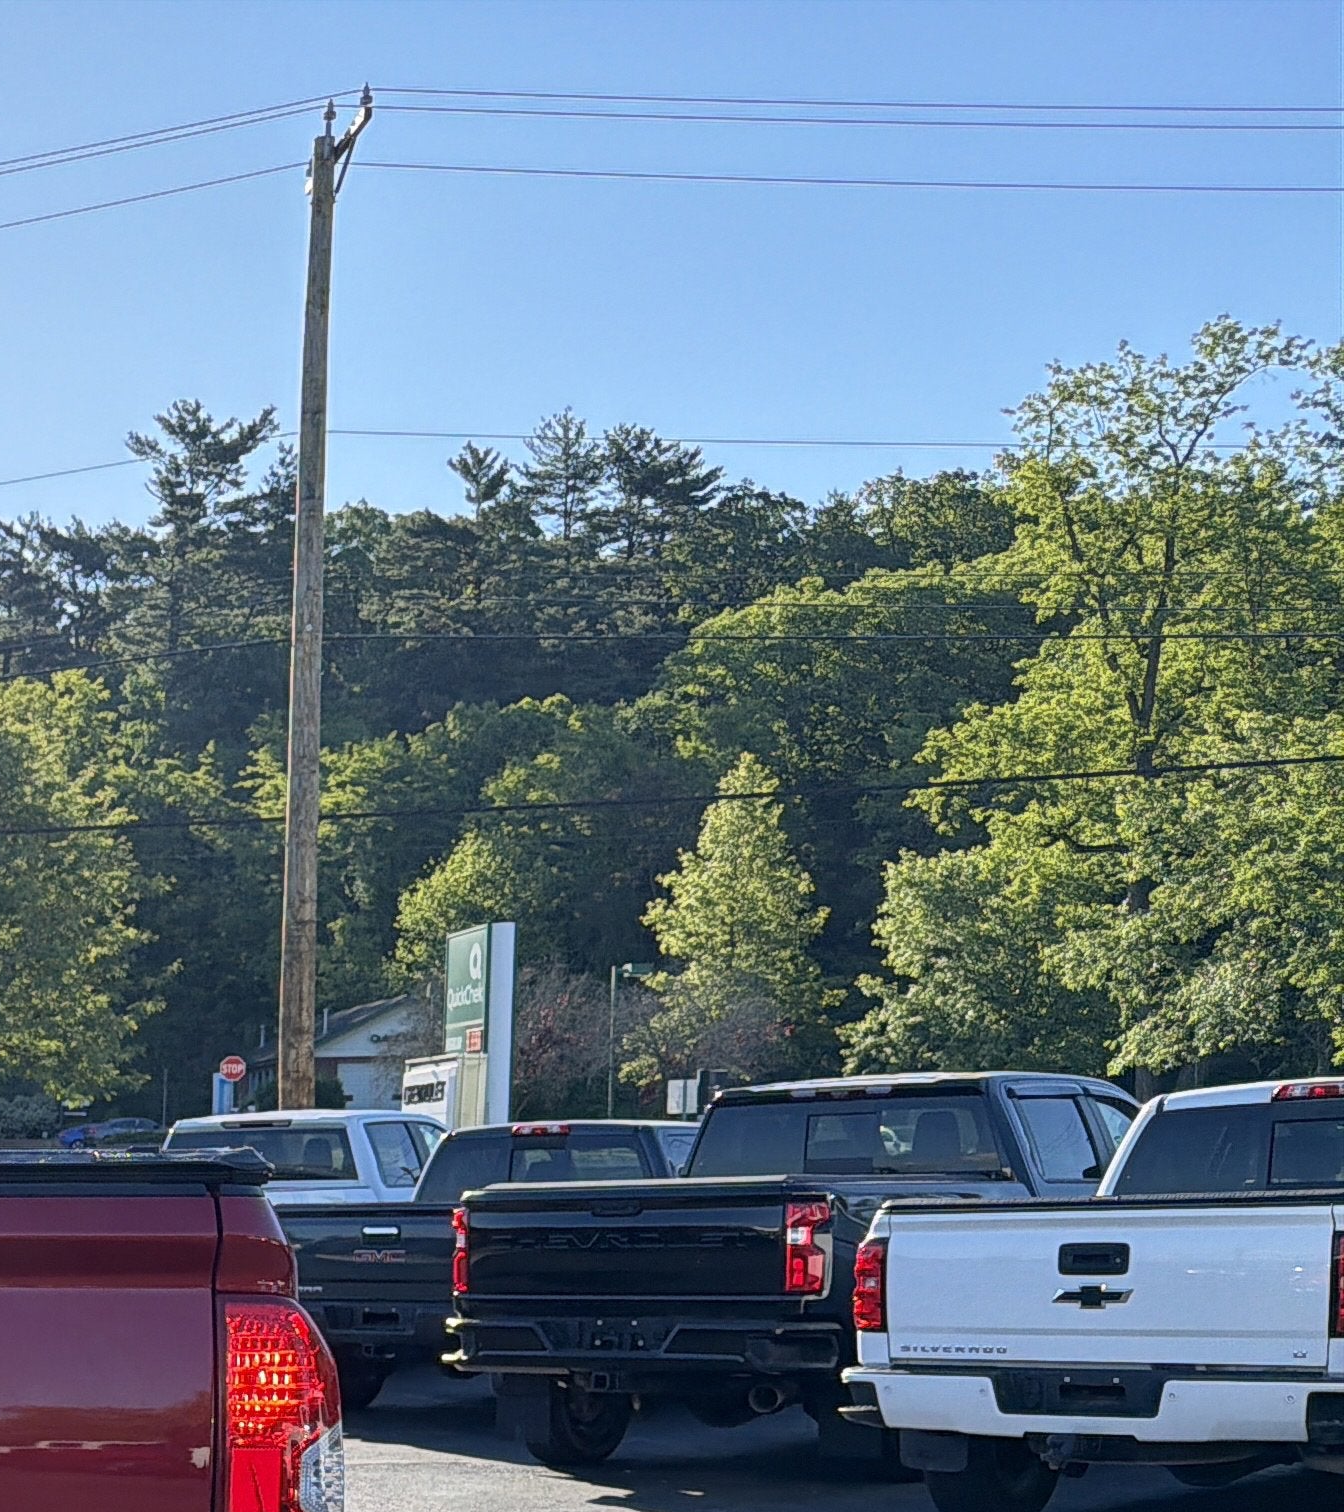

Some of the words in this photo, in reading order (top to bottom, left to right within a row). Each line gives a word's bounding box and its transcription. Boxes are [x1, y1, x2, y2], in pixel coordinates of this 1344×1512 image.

[222, 1063, 243, 1074] STOP
[353, 1249, 406, 1263] GMC
[900, 1344, 1008, 1355] SILVERADO
